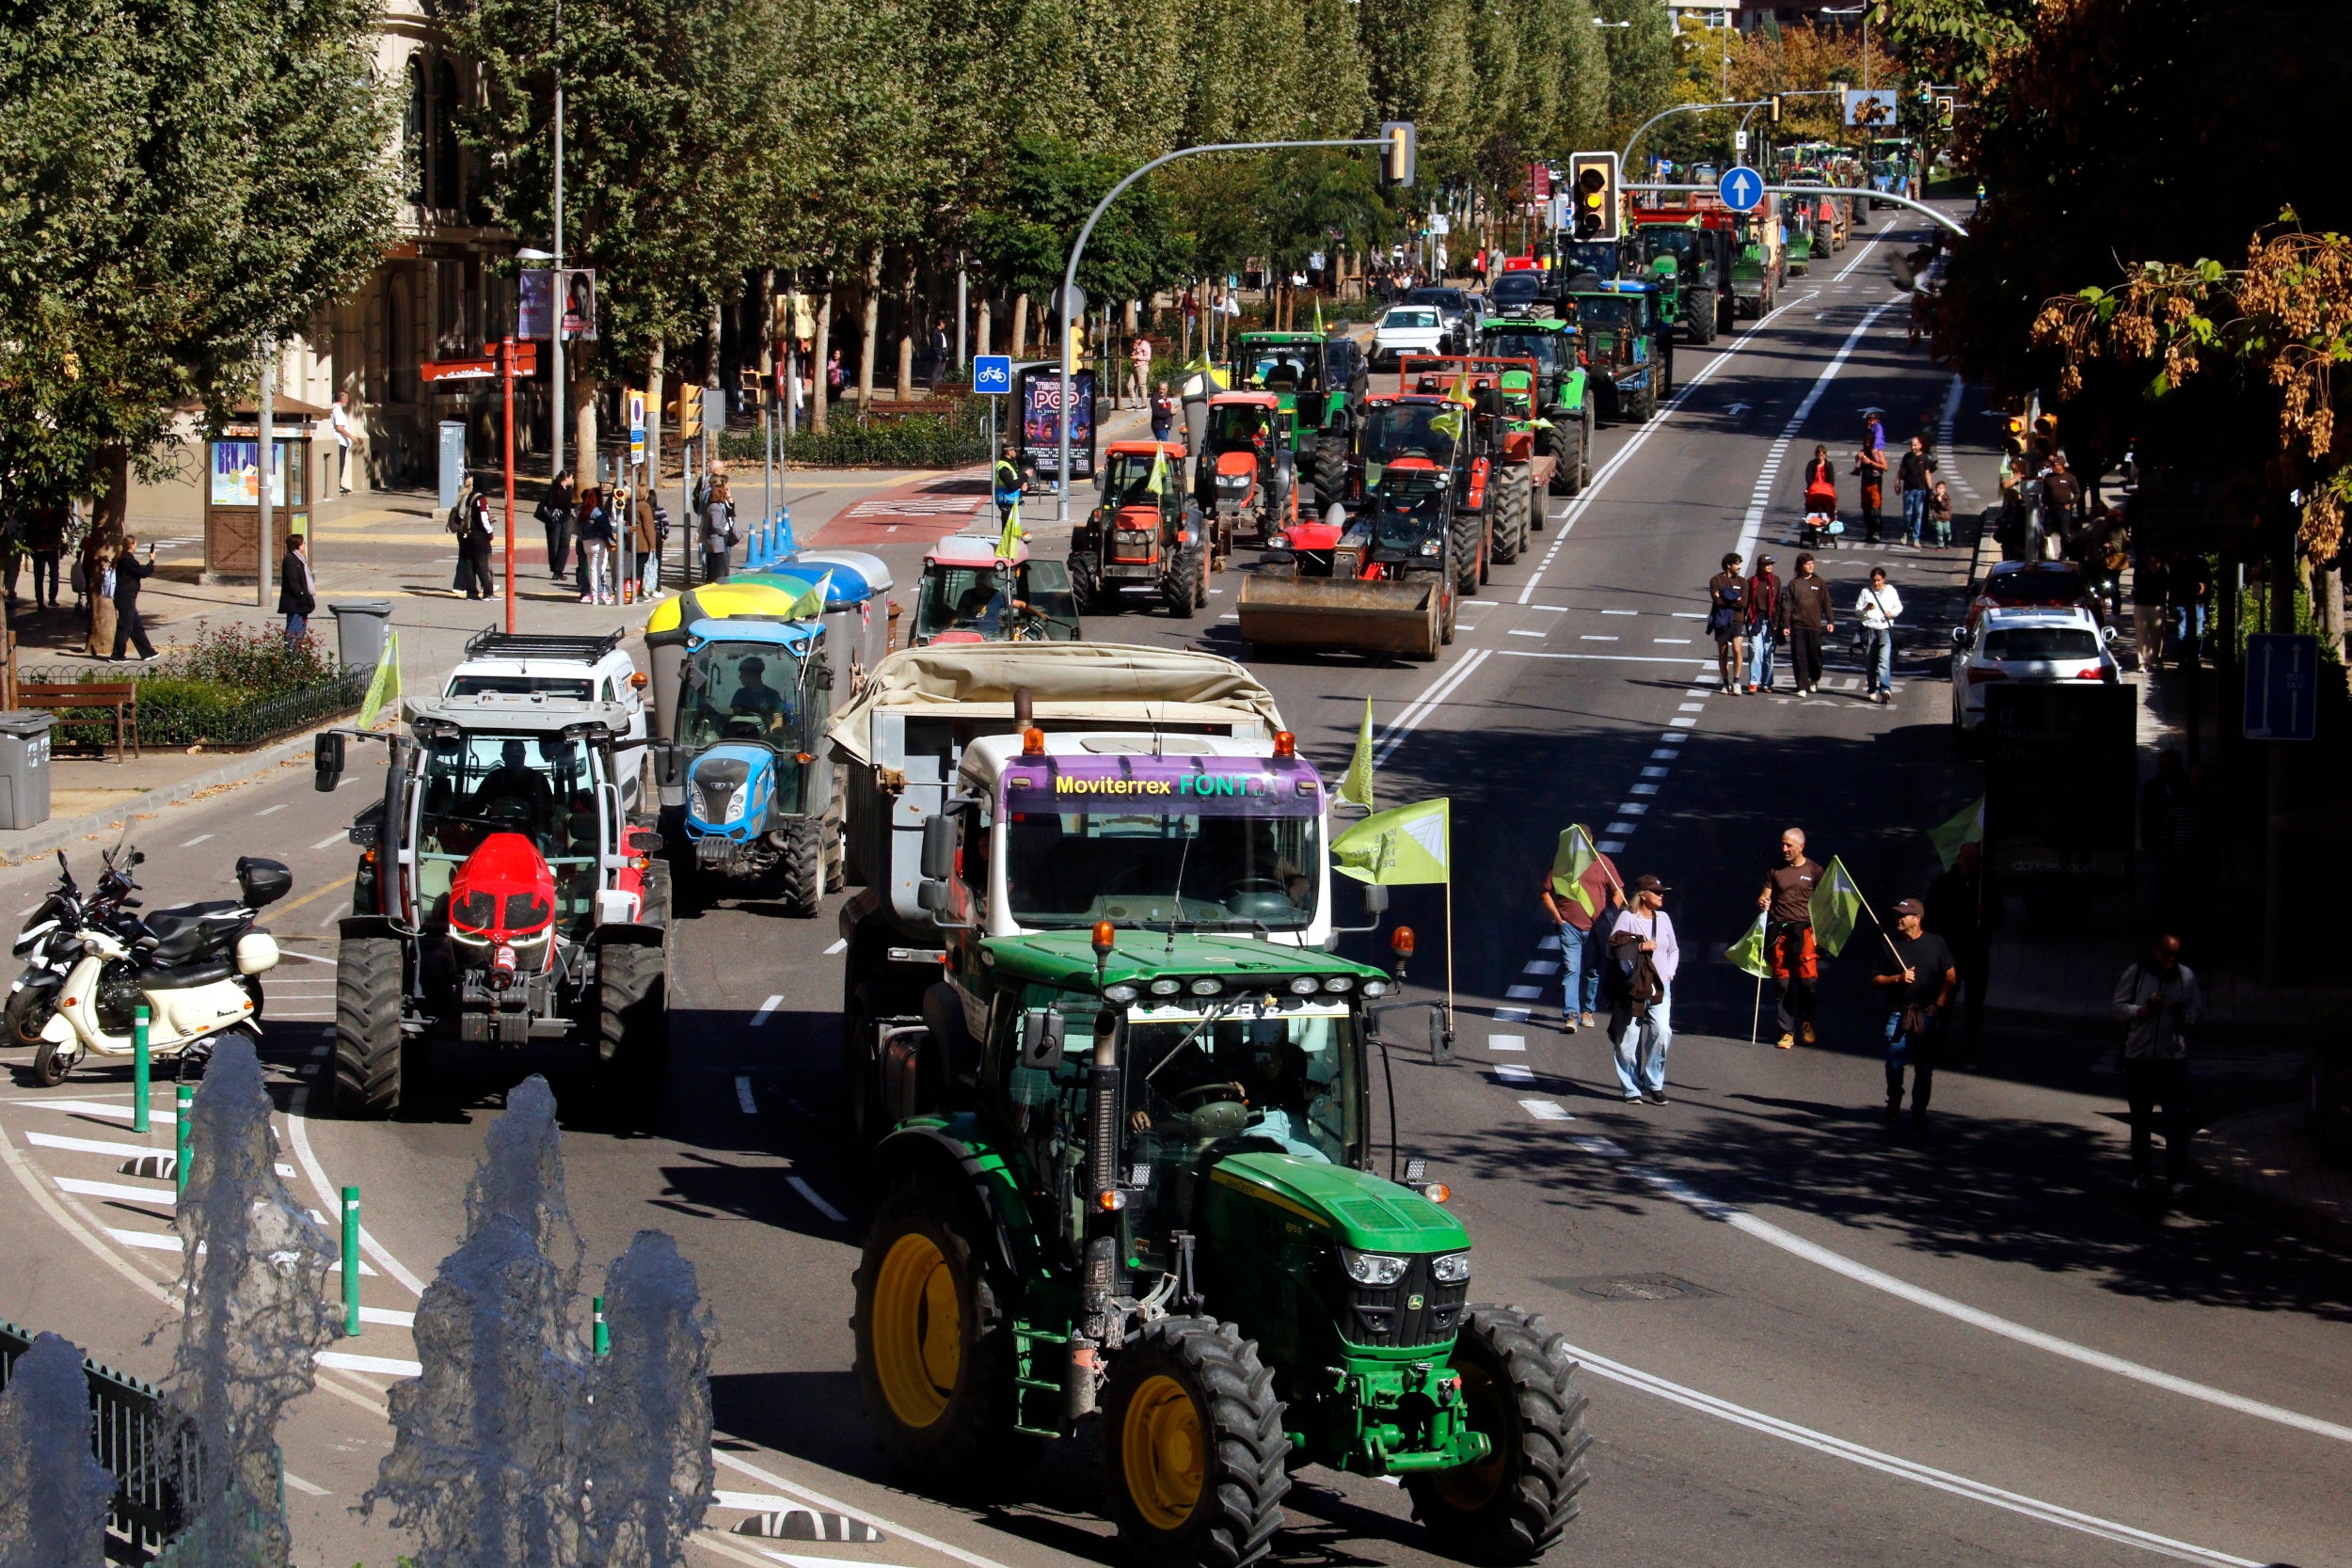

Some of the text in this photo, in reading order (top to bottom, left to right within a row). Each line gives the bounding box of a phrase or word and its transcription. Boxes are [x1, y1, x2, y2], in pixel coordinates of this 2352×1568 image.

[1036, 381, 1077, 391] TECHO
[1034, 390, 1079, 409] POP
[218, 442, 239, 474] BEN
[243, 442, 278, 475] JUT
[1056, 776, 1171, 794] Moviterrex
[1180, 774, 1250, 796] FONT
